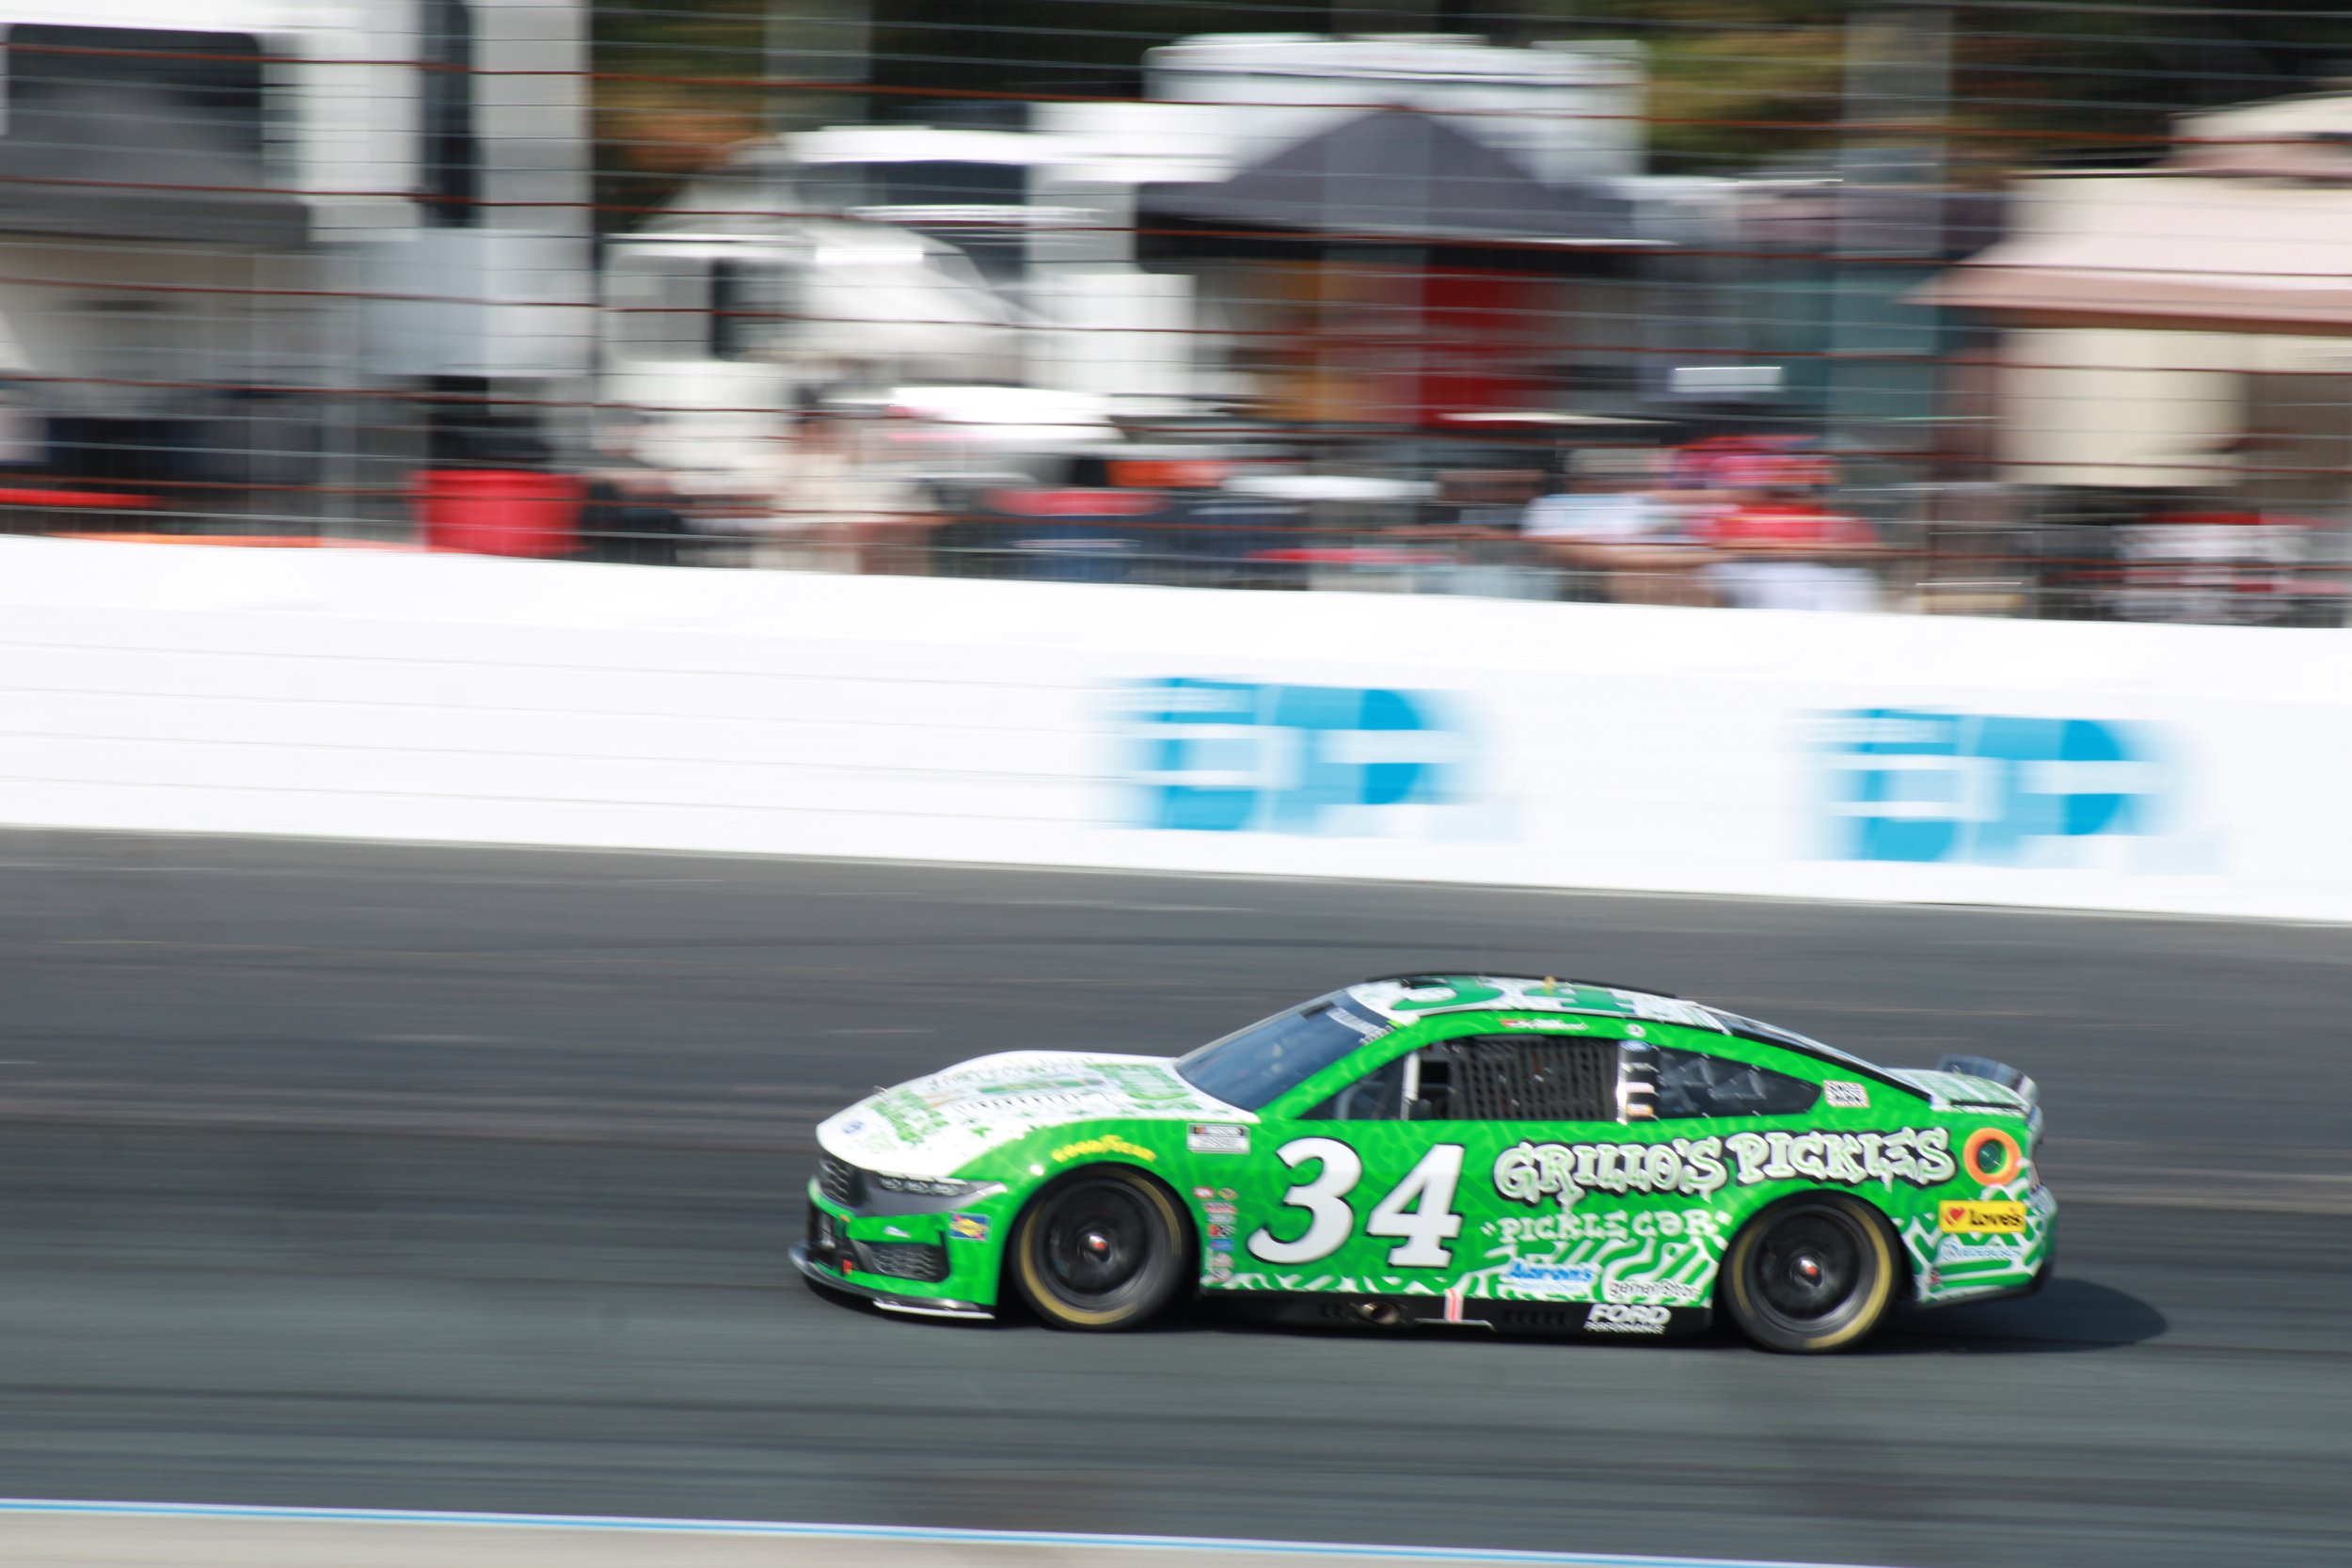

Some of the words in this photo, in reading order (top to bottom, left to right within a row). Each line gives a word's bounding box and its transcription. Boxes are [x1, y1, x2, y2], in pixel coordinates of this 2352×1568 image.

[1247, 1136, 1465, 1268] 34
[1493, 1135, 1727, 1207] GRILLO'S
[1725, 1127, 1957, 1188] PICKLES
[1587, 1303, 1672, 1325] FORD
